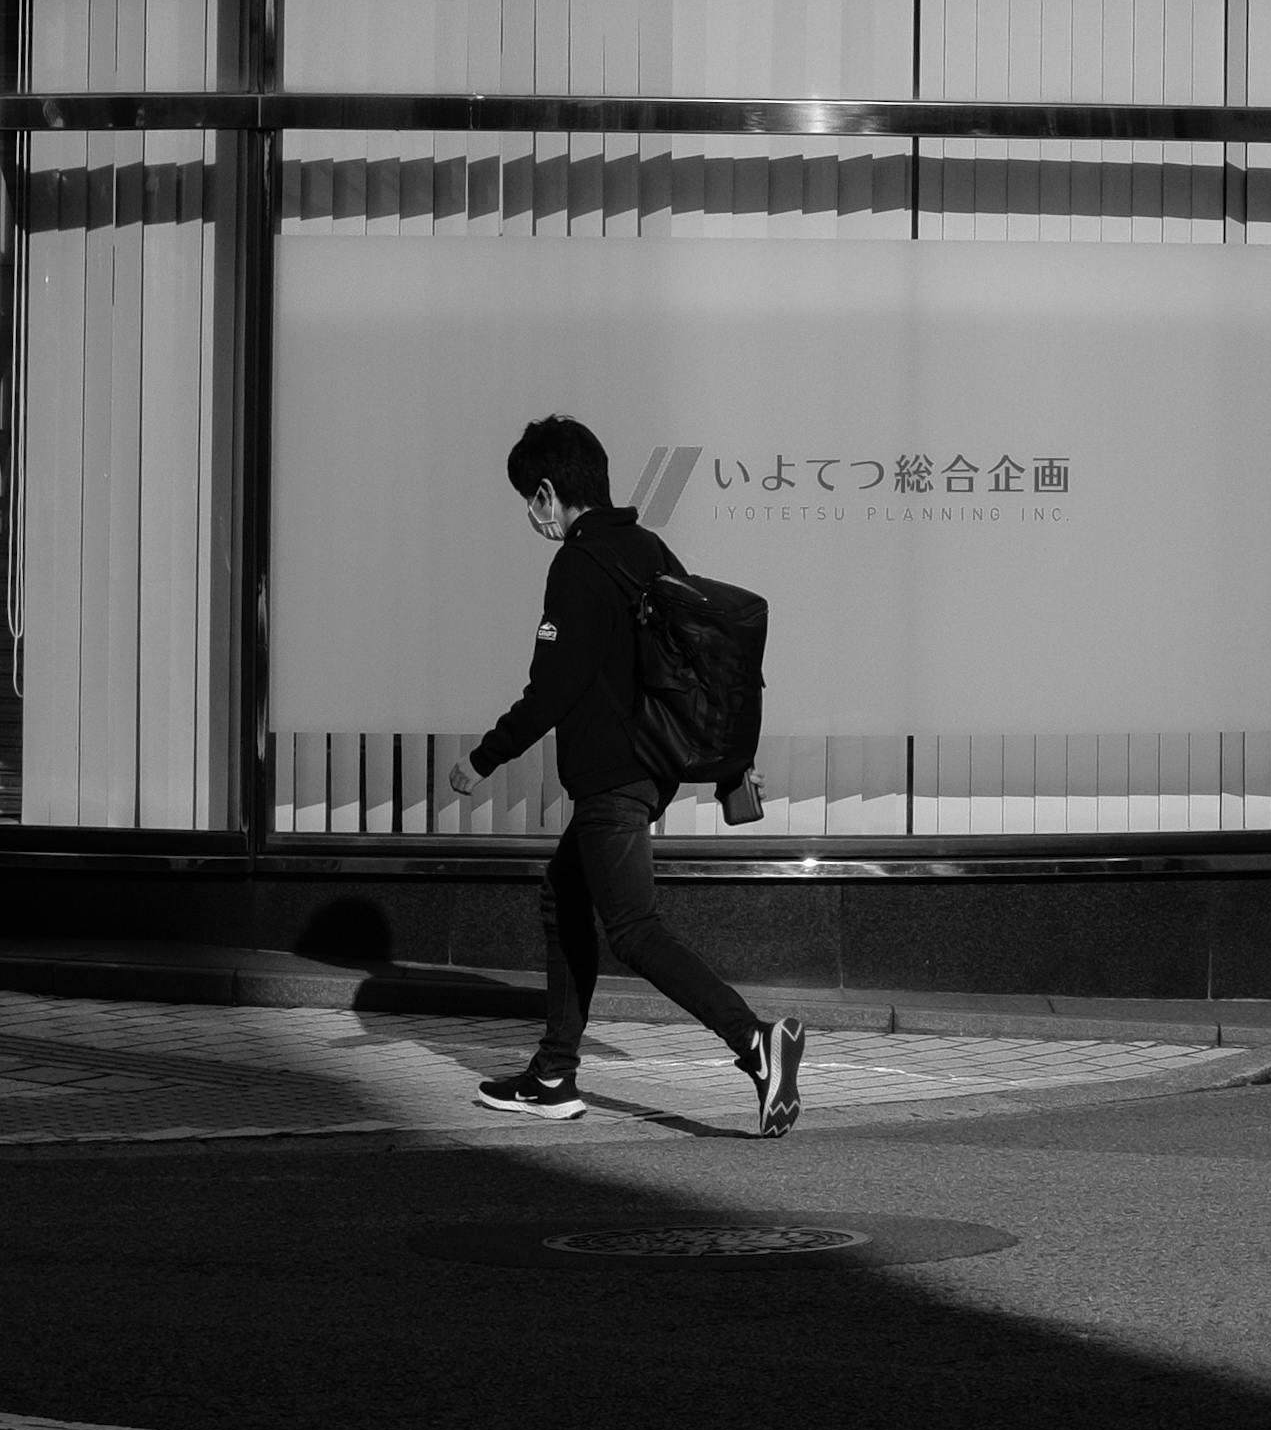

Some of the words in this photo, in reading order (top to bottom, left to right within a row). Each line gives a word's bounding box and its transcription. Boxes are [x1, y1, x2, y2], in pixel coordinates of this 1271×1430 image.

[714, 453, 1070, 493] いよてつ総合企画
[713, 506, 845, 521] IYOTETSU
[867, 506, 1000, 522] PLANNING
[1020, 507, 1070, 522] INC.
